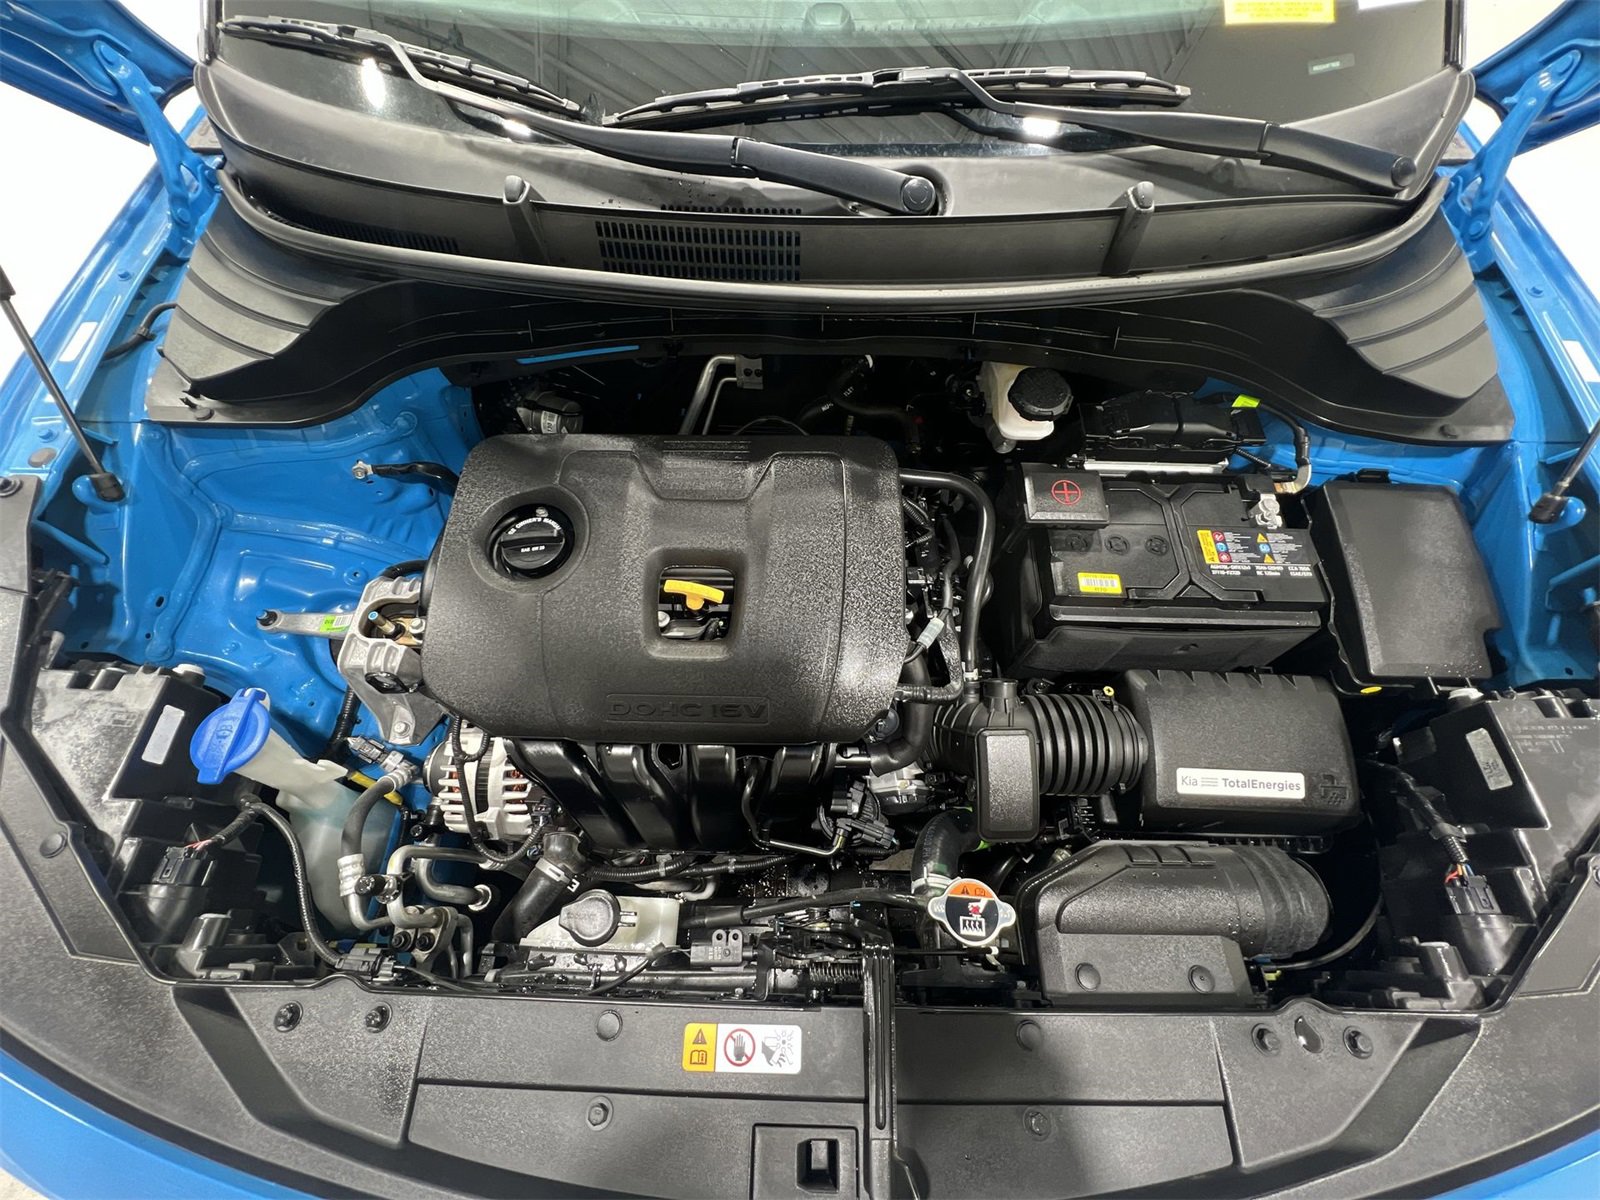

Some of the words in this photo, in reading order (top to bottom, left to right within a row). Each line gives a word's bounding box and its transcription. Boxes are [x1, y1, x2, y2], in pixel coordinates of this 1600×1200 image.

[608, 701, 703, 718] DOHC
[1181, 775, 1198, 787] Kia
[1222, 778, 1301, 792] TotalEnergies
